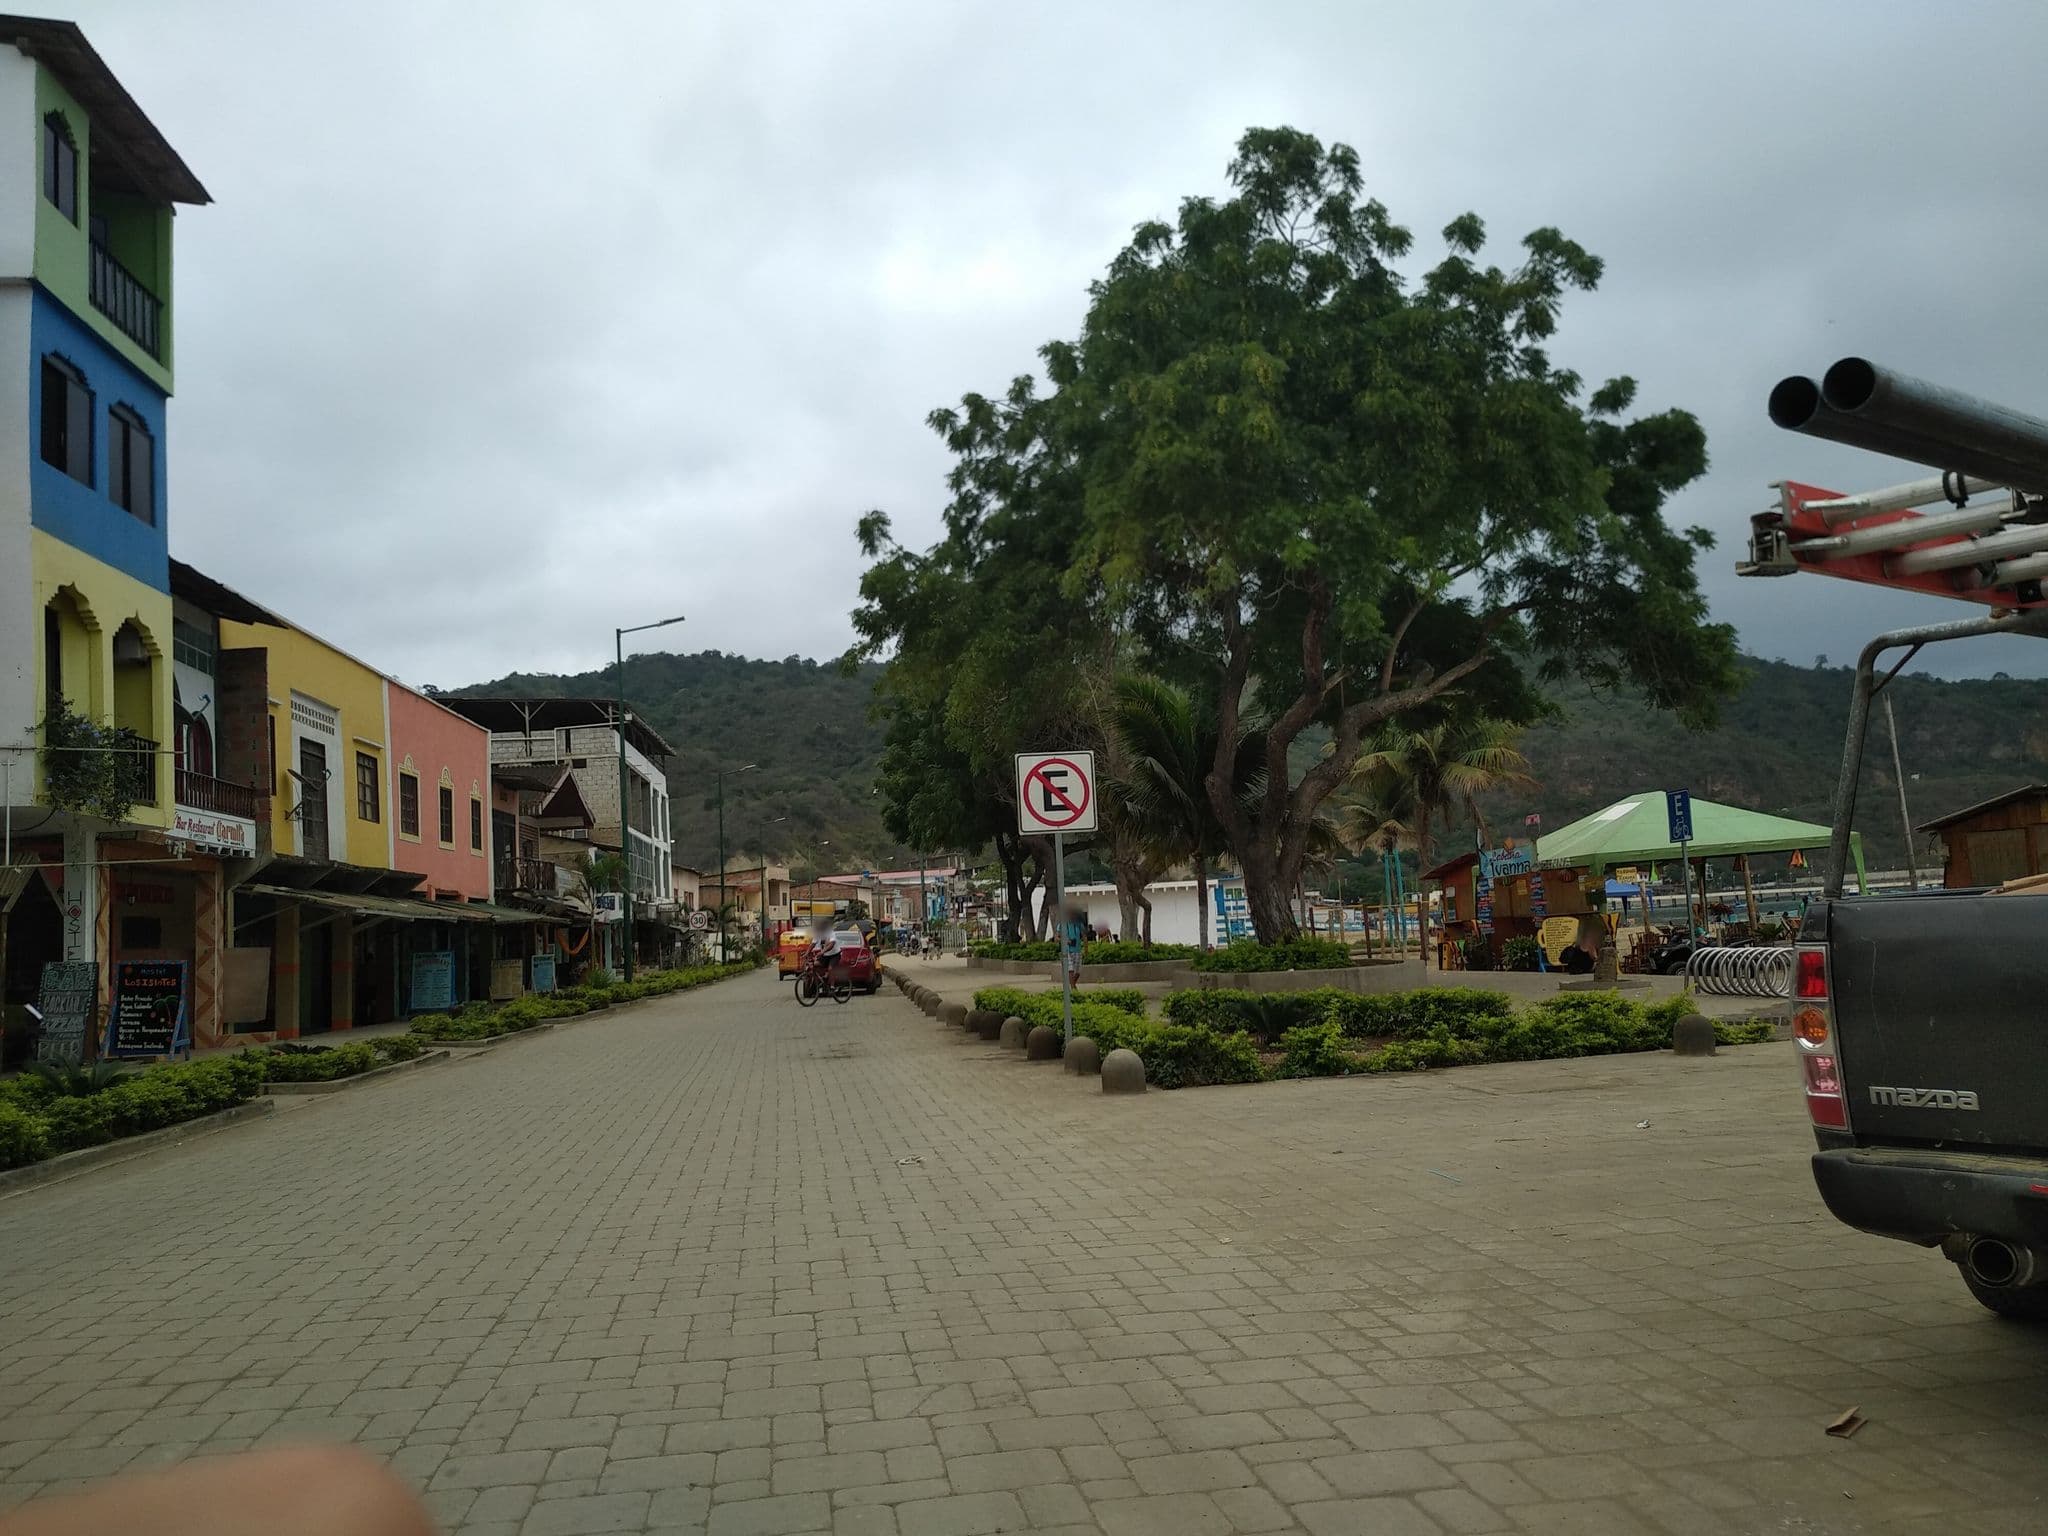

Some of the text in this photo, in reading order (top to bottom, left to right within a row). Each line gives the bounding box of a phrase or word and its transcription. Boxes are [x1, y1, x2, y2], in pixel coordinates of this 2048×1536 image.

[1043, 770, 1072, 812] E
[1674, 794, 1683, 816] E
[1491, 860, 1530, 877] Ivanna
[693, 916, 704, 925] 30
[1869, 1086, 1979, 1111] mazda
